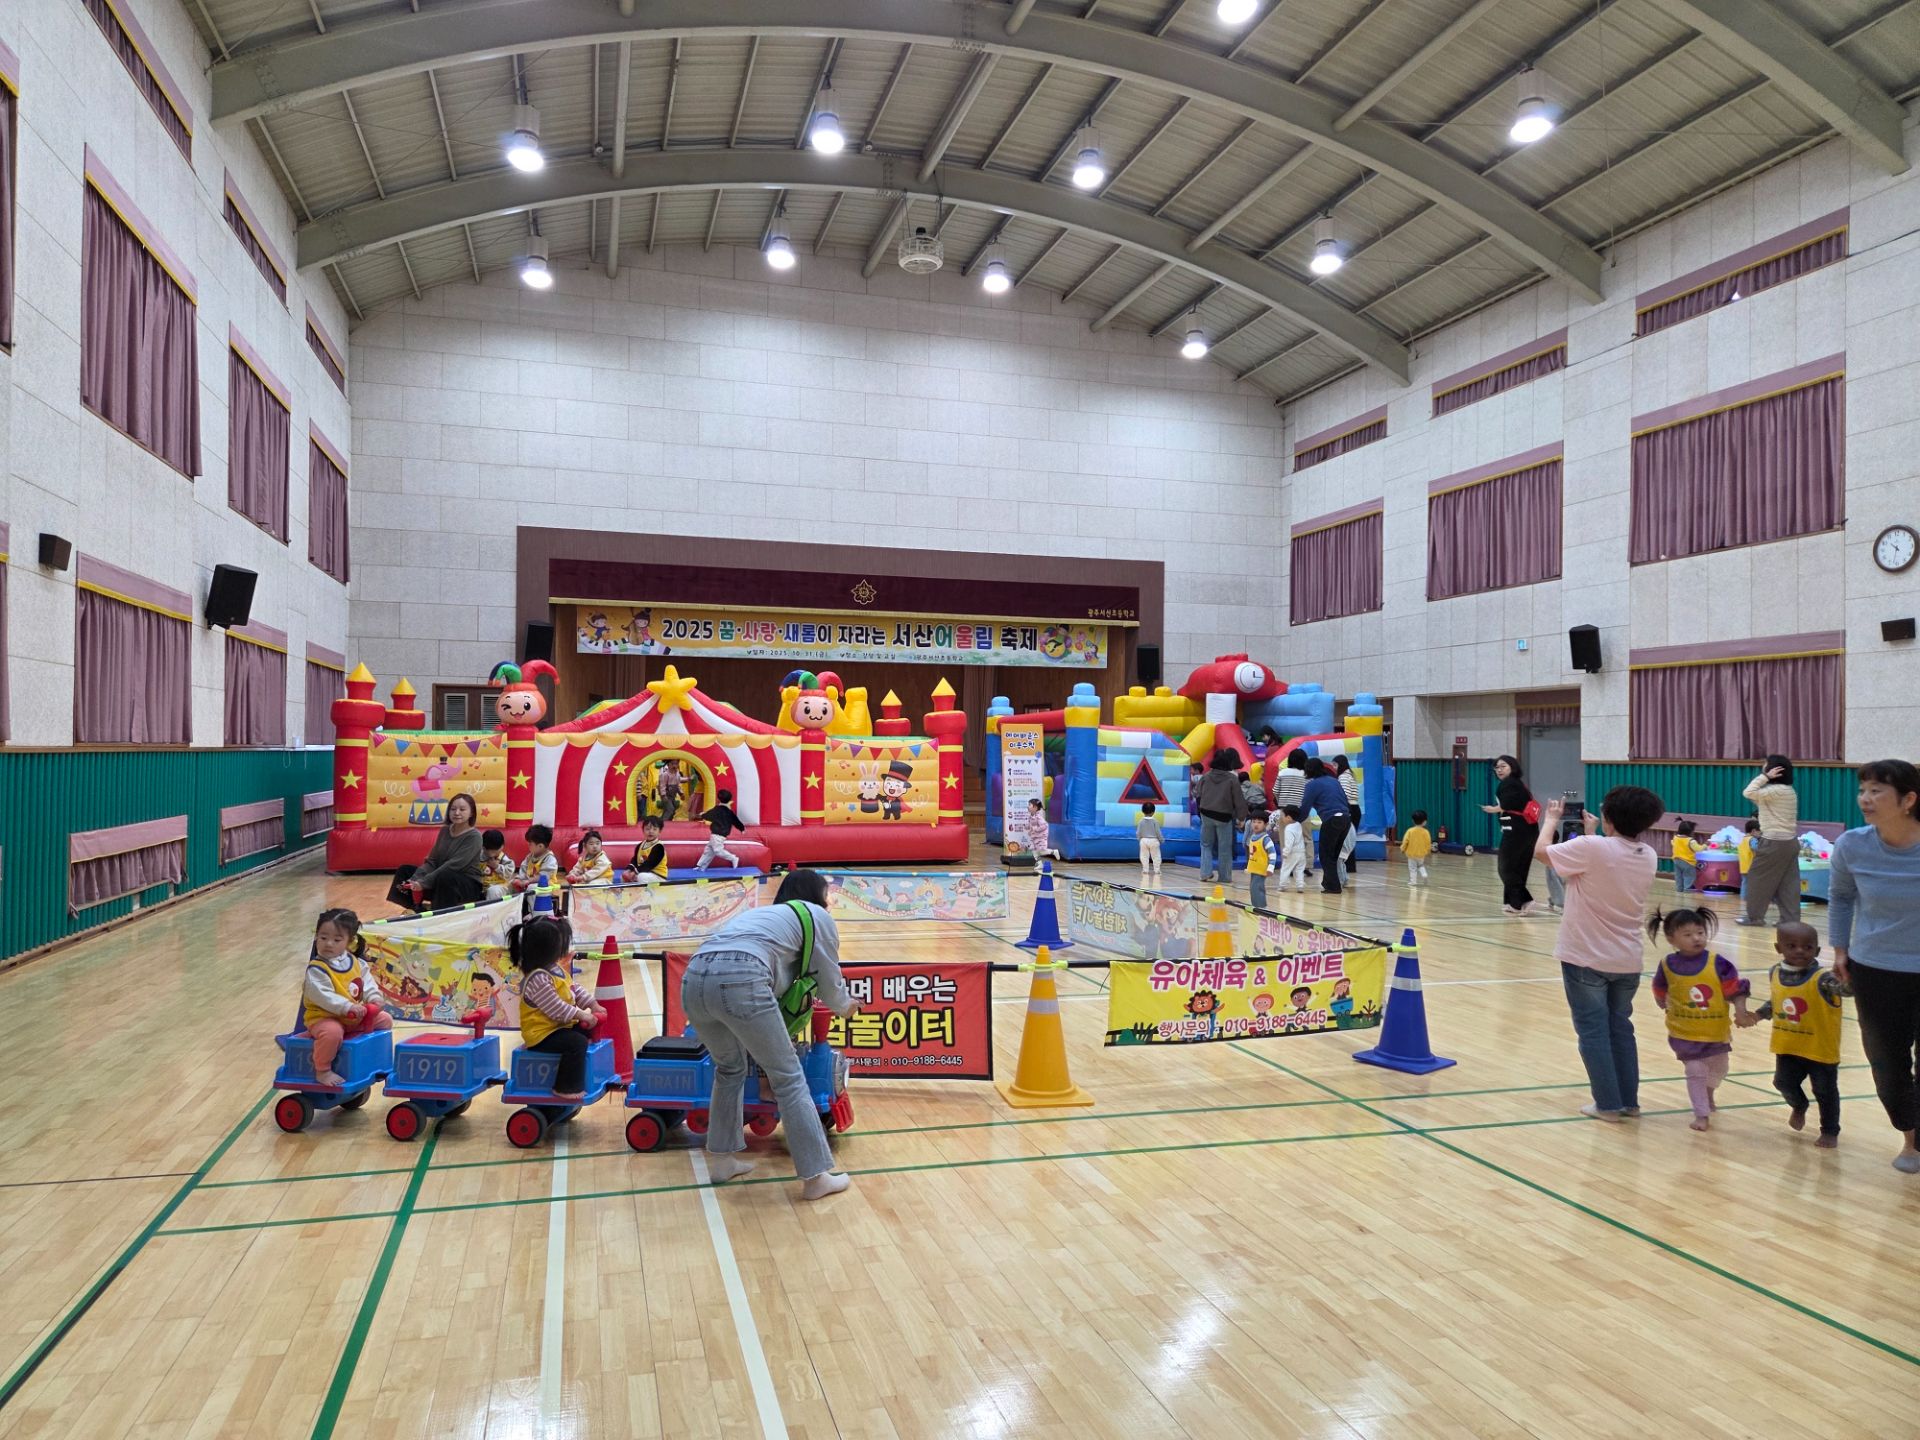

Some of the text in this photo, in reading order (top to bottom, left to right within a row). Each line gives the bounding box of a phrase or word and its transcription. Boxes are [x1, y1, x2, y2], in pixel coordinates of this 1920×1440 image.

[662, 619, 1038, 651] 2025 꿈·사랑·새롬이 자라는 서산어울림 축제
[1149, 953, 1343, 990] 유아체육 & 이벤트
[883, 975, 957, 1002] 배우는
[1158, 1019, 1211, 1038] 행사문의
[1224, 1010, 1327, 1033] 010-9188-6445
[407, 1057, 457, 1081] 1919
[891, 1056, 963, 1066] 010-9188-6445
[644, 1074, 691, 1089] TRAIN
